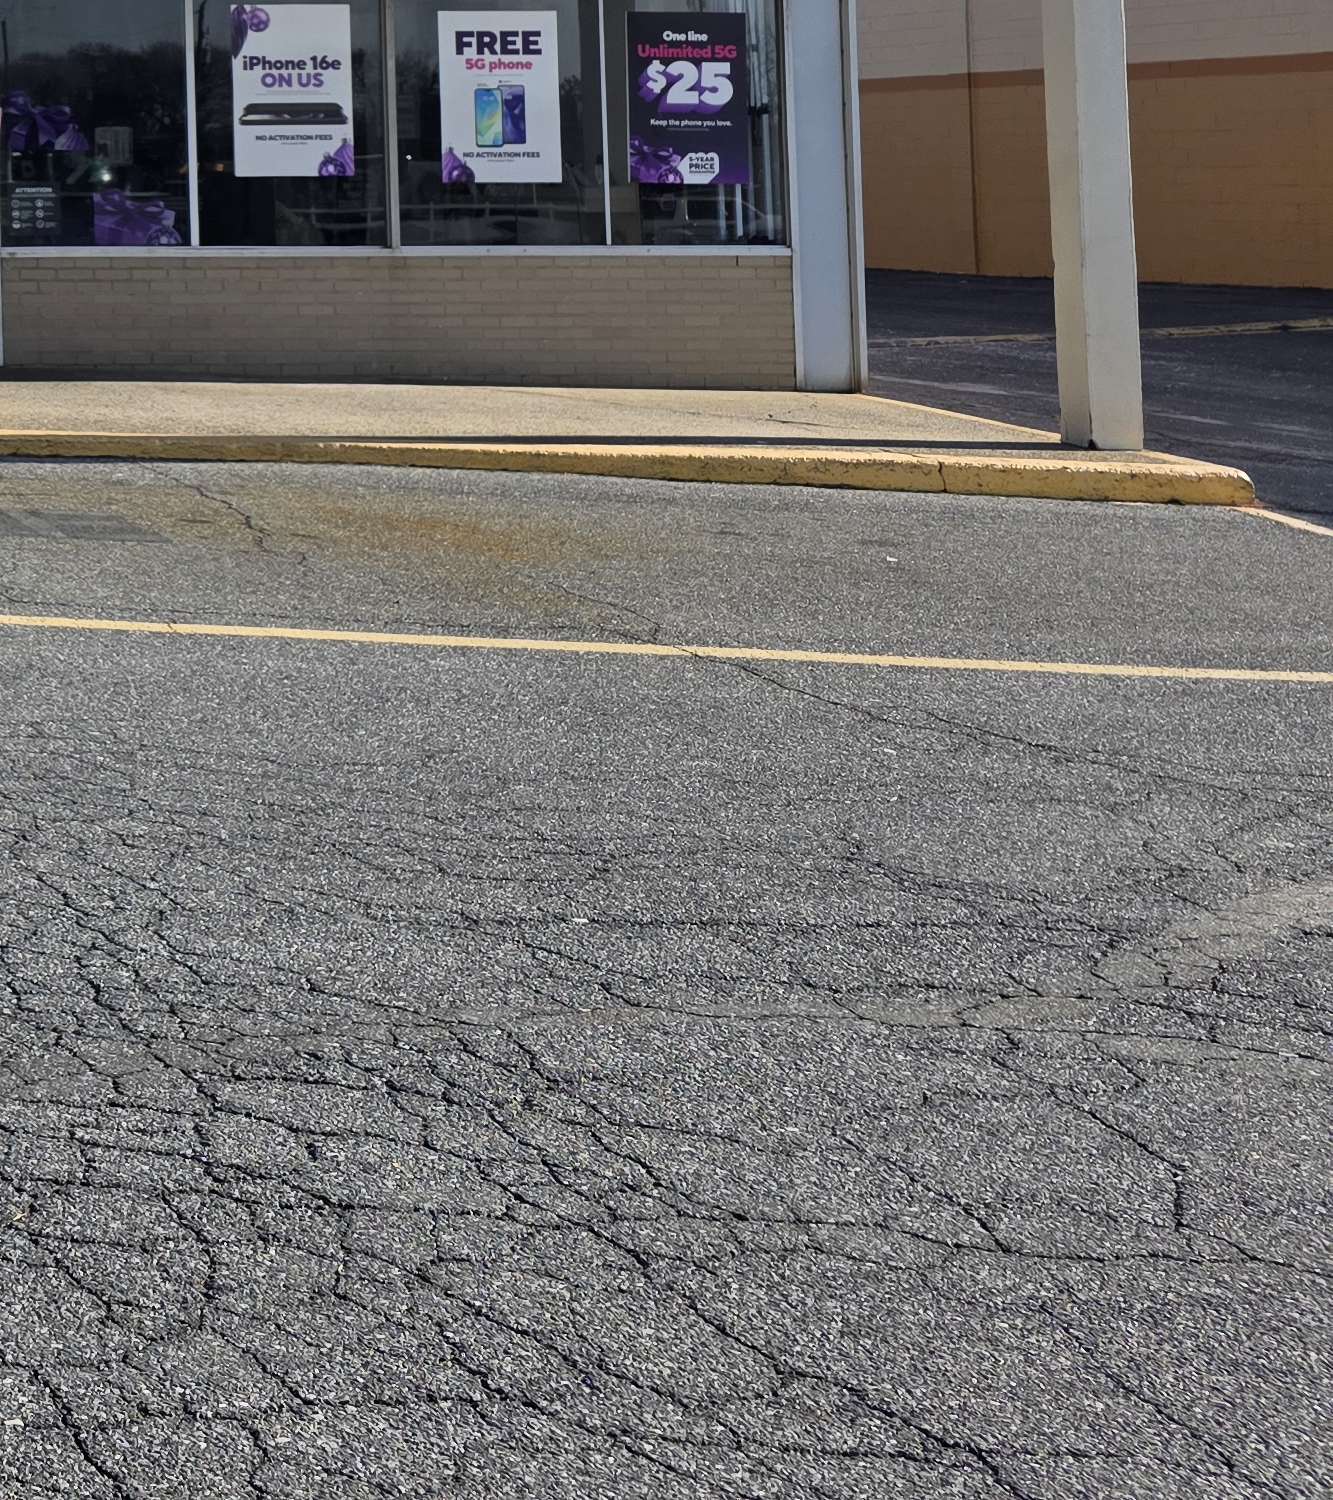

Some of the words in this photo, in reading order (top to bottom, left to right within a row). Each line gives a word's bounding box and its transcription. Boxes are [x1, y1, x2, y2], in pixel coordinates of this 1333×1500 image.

[455, 30, 542, 55] FREE
[663, 31, 686, 41] One
[687, 30, 708, 41] line
[638, 44, 713, 58] Unlimited
[714, 45, 737, 58] 5G
[242, 55, 307, 71] iPhone
[309, 55, 342, 71] 16e
[465, 58, 486, 70] 5G
[489, 58, 533, 73] phone
[260, 72, 293, 88] ON
[297, 72, 324, 88] US
[646, 59, 734, 106] $25
[650, 119, 668, 127] Keep
[680, 119, 702, 127] phone
